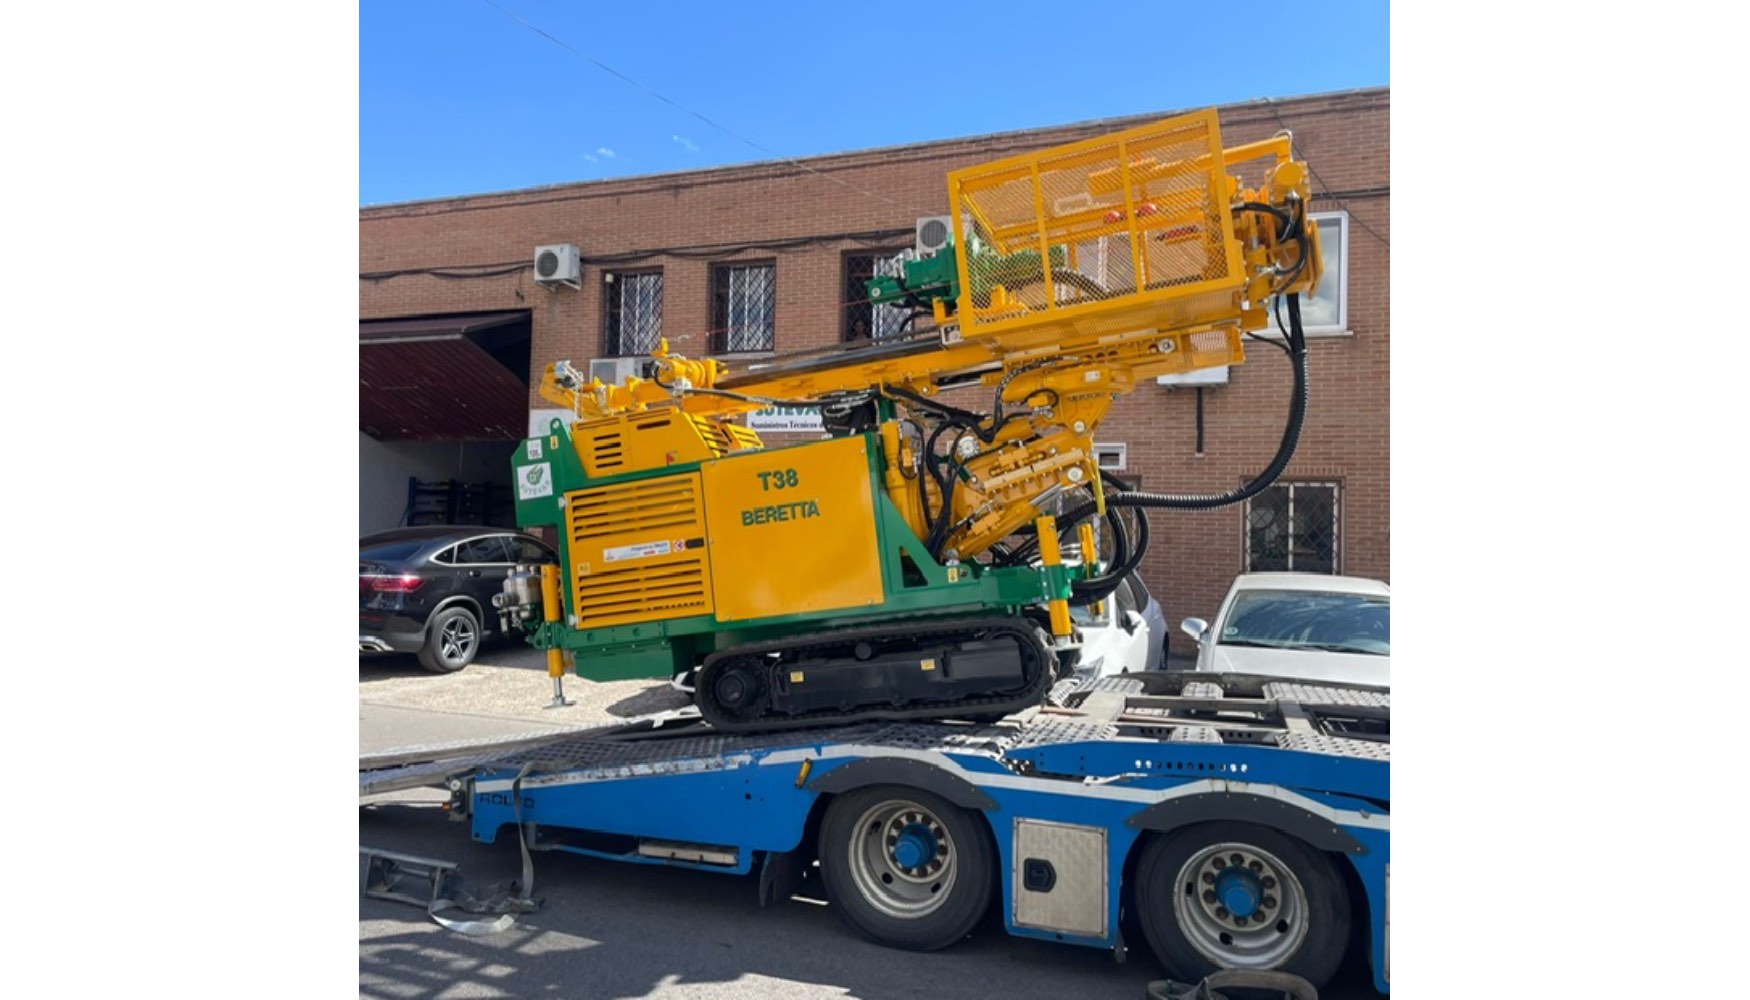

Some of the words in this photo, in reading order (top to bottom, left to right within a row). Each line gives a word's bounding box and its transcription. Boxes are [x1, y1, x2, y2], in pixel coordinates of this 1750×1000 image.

[790, 420, 817, 429] Técnicos
[757, 468, 799, 491] T38
[741, 500, 820, 527] BERETTA
[479, 793, 535, 808] ROLO
